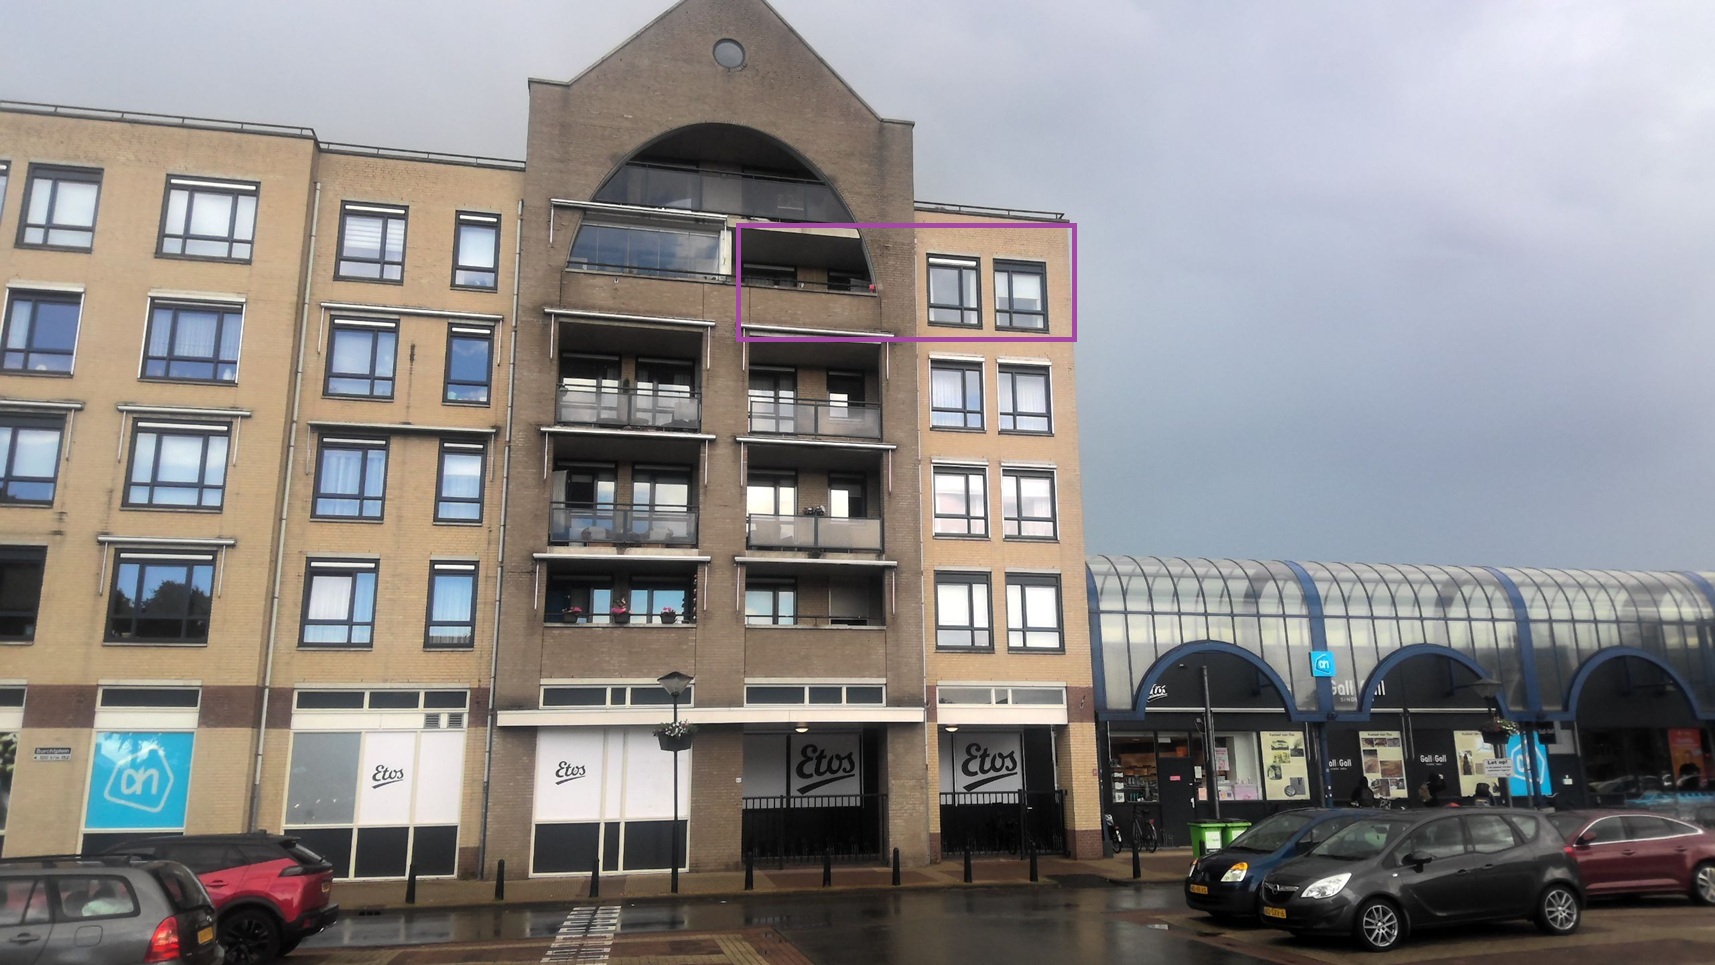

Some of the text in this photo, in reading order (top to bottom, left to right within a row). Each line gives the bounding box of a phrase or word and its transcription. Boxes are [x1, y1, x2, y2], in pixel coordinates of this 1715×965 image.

[555, 760, 586, 778] Etos
[796, 744, 855, 779] Etos
[961, 743, 1018, 777] Etos
[1329, 759, 1351, 767] all Gall
[372, 764, 404, 781] Etos
